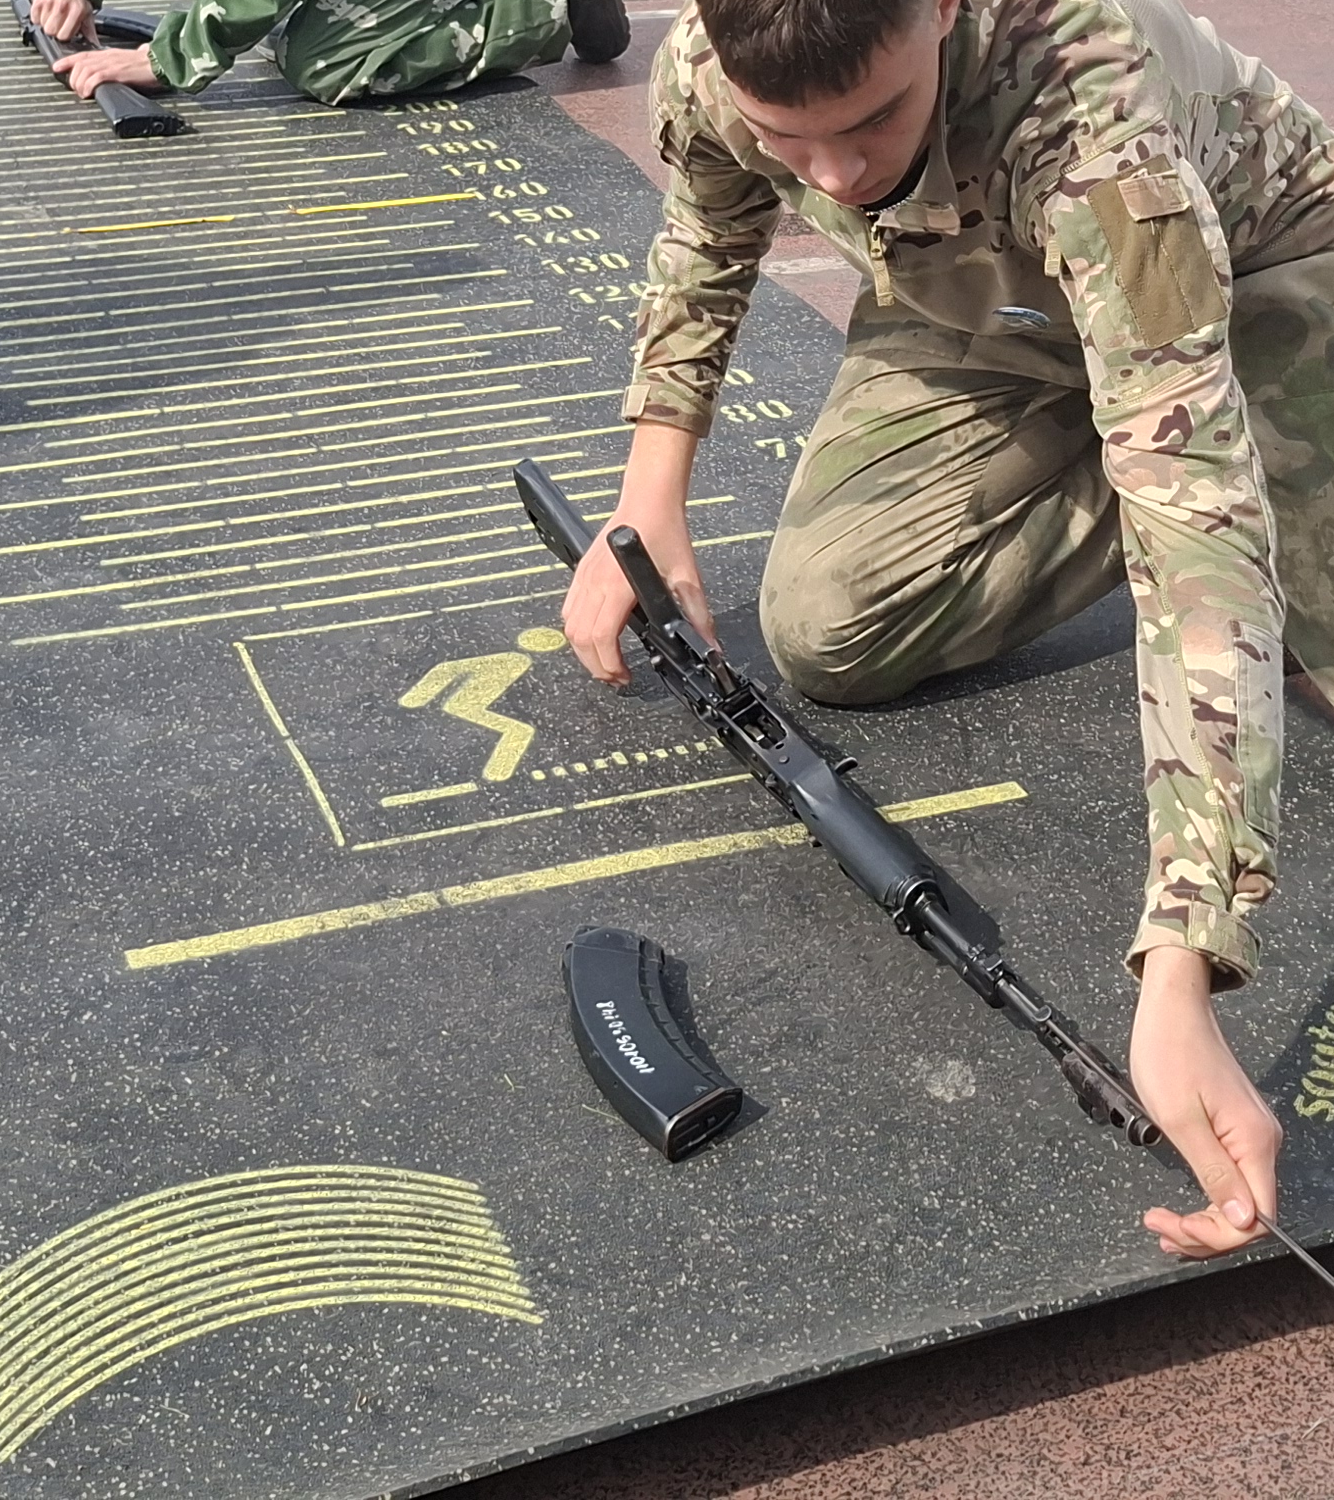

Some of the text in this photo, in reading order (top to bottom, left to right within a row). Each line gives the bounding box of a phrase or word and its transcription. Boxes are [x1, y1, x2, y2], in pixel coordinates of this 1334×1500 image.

[397, 119, 476, 135] 190
[418, 139, 499, 156] 180
[441, 158, 522, 177] 170
[464, 181, 549, 201] 160
[488, 205, 574, 225] 150
[514, 228, 601, 247] 140
[540, 253, 631, 275] 130
[720, 399, 793, 424] 80
